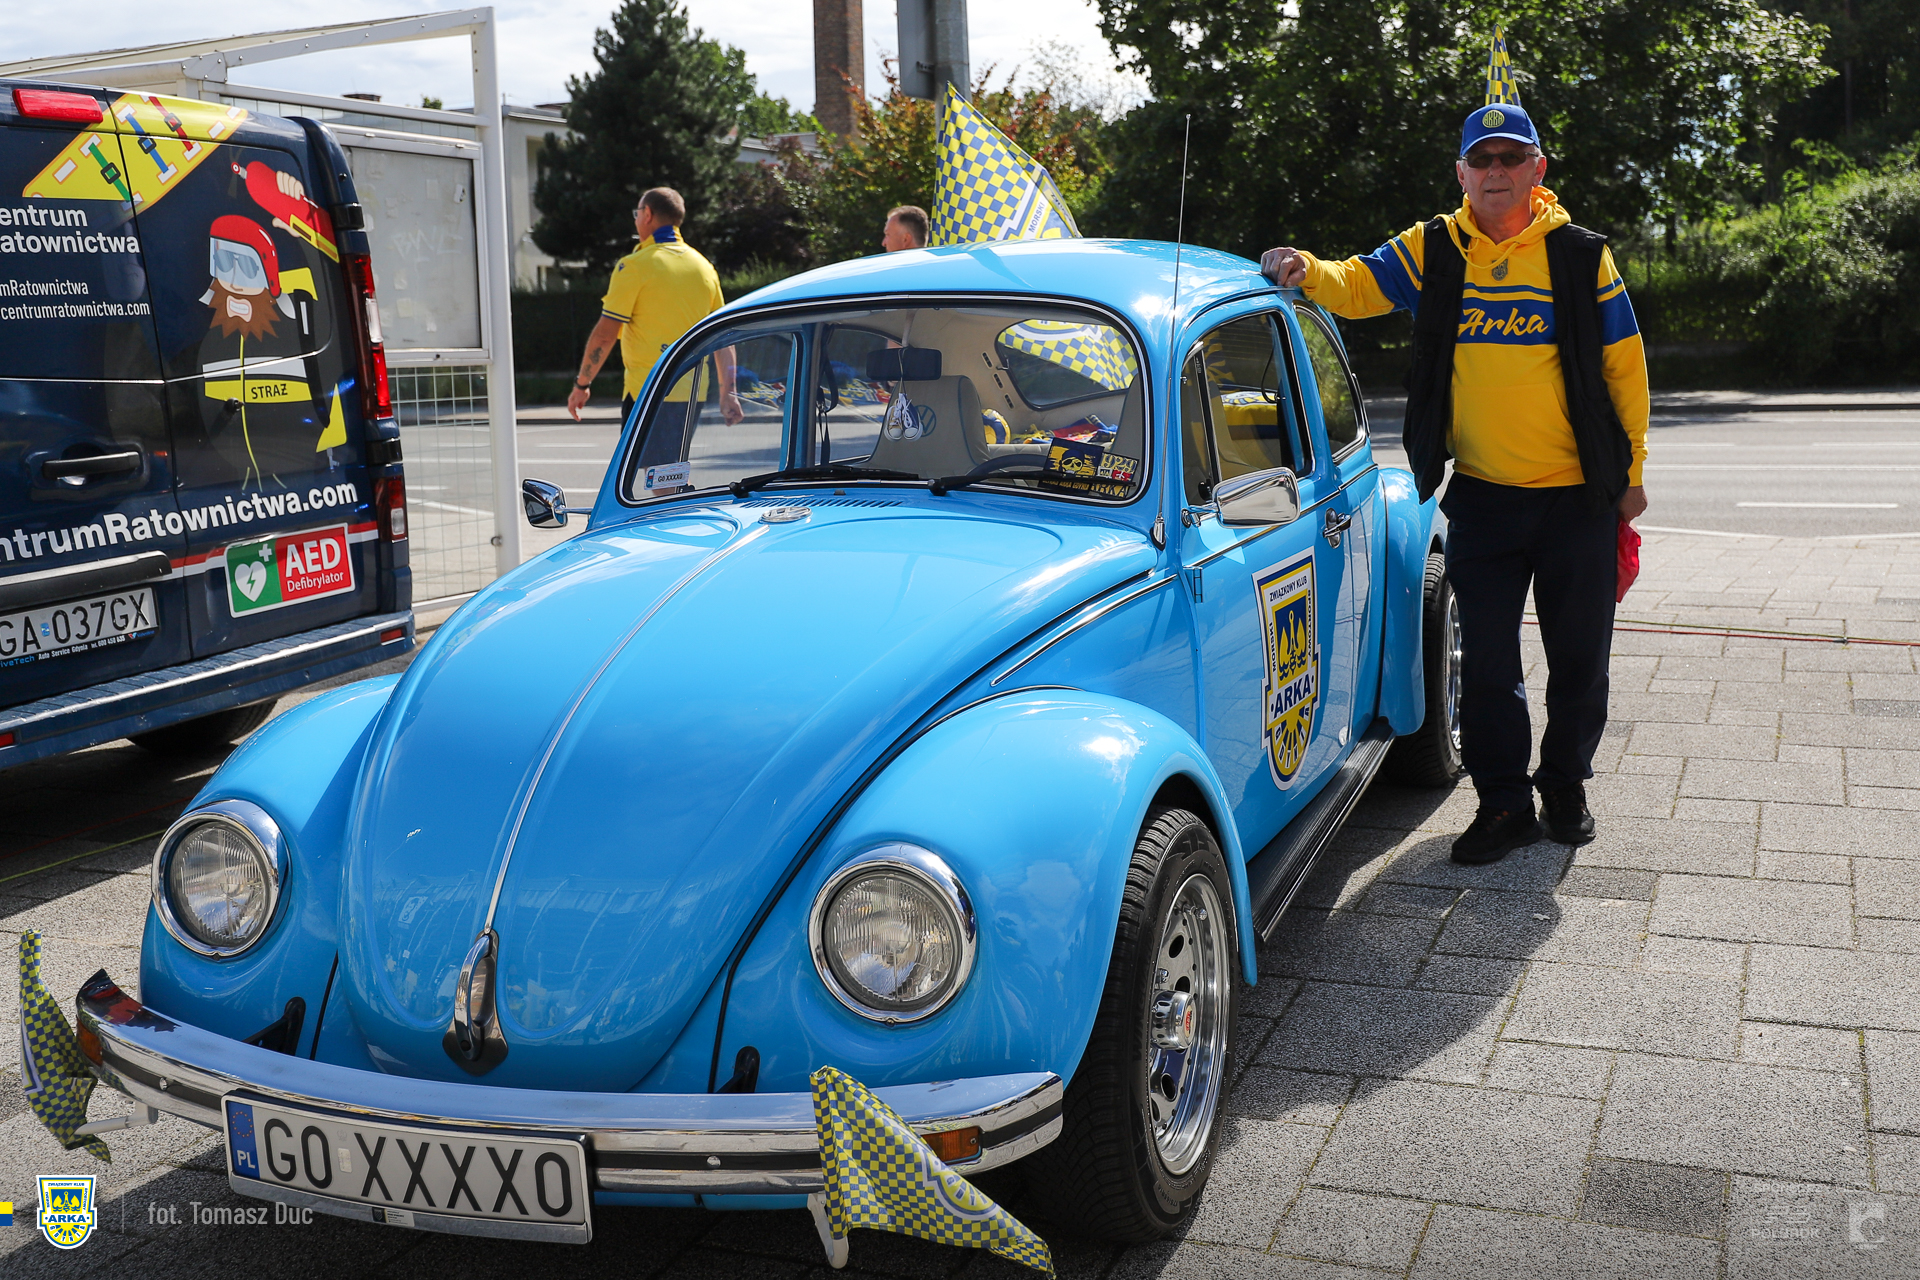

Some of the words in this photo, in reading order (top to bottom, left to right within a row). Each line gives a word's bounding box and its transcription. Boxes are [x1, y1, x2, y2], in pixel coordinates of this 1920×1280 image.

[1028, 202, 1046, 233] MORSKI
[1457, 307, 1549, 338] Arka
[286, 538, 341, 578] AED
[287, 571, 344, 593] Defibrylator
[1269, 581, 1296, 602] ZWIĄZKOWY
[1296, 575, 1308, 589] KLUB
[0, 616, 41, 657] GA
[51, 592, 150, 645] 037GX
[38, 652, 50, 661] Auto
[51, 648, 70, 658] Service
[71, 643, 89, 655] Gdynia
[1274, 674, 1311, 719] ARKA
[237, 1150, 256, 1169] PL
